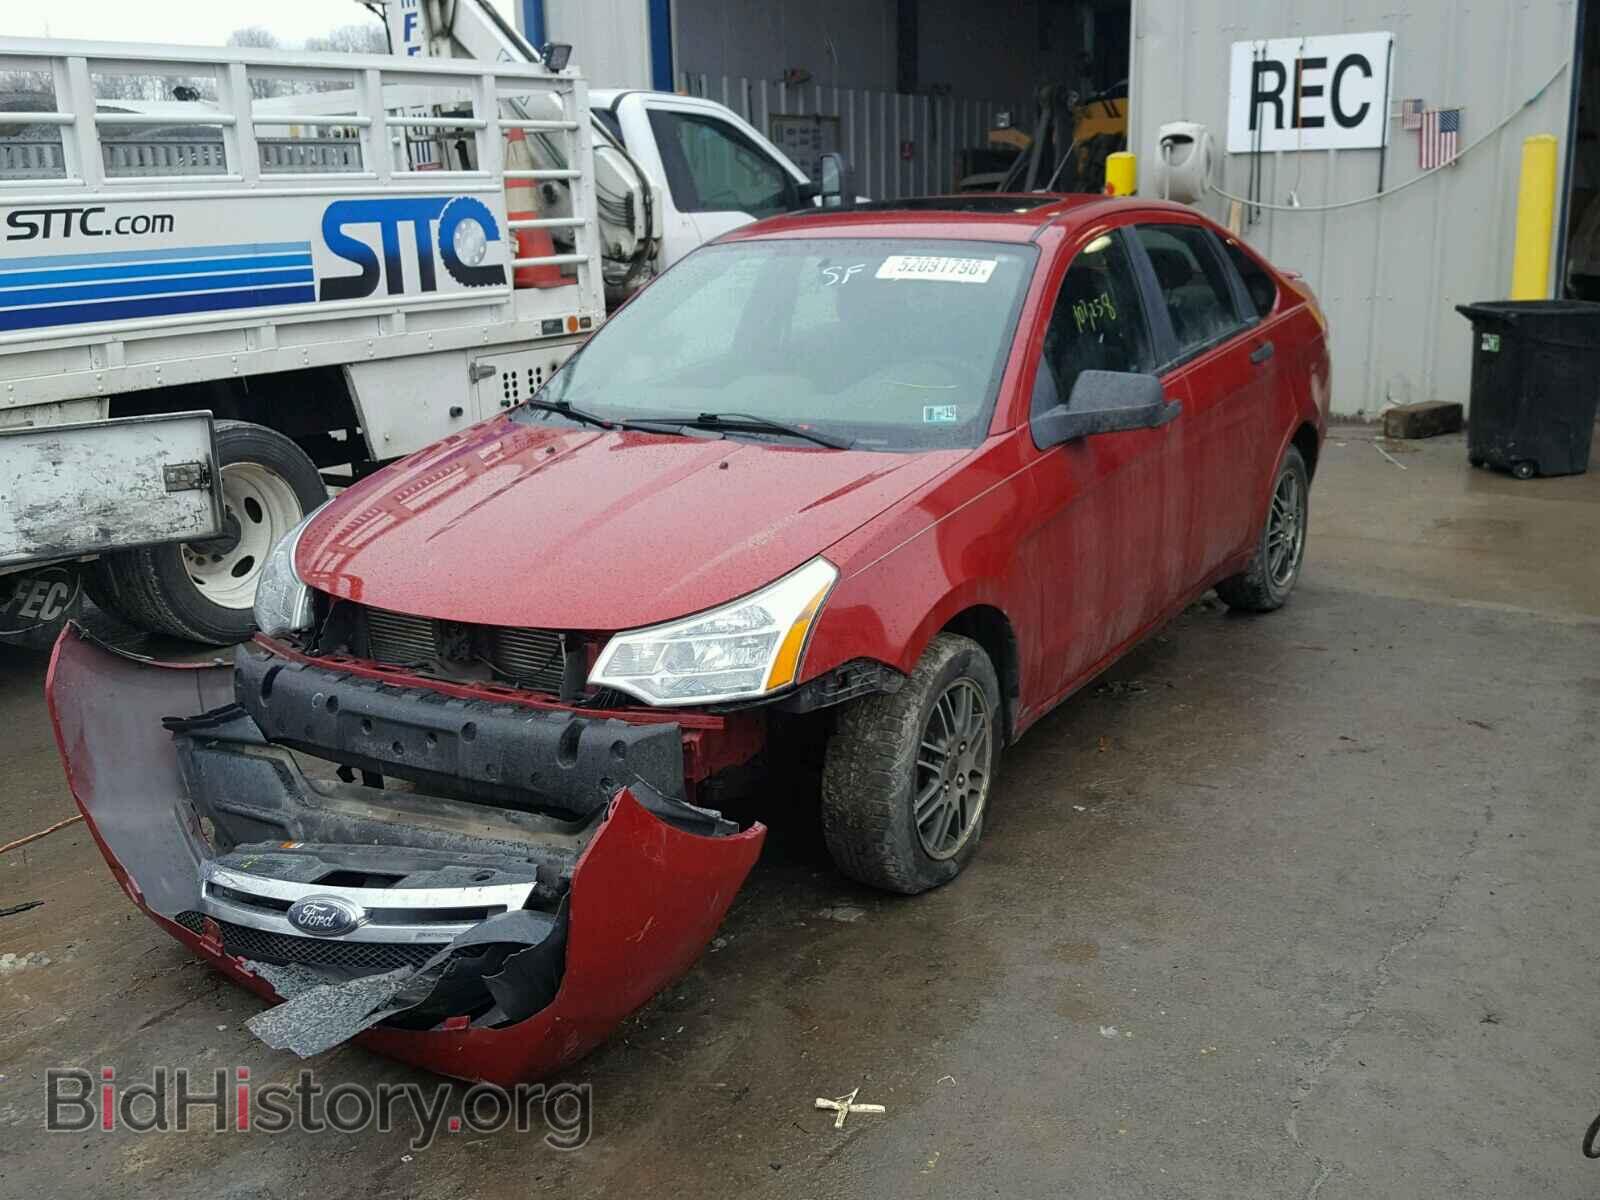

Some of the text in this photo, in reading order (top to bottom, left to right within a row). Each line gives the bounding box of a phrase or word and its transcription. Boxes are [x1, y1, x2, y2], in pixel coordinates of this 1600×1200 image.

[1249, 53, 1372, 130] REC
[7, 207, 174, 240] STTC.com
[319, 195, 507, 302] STTC
[298, 904, 337, 927] Ford
